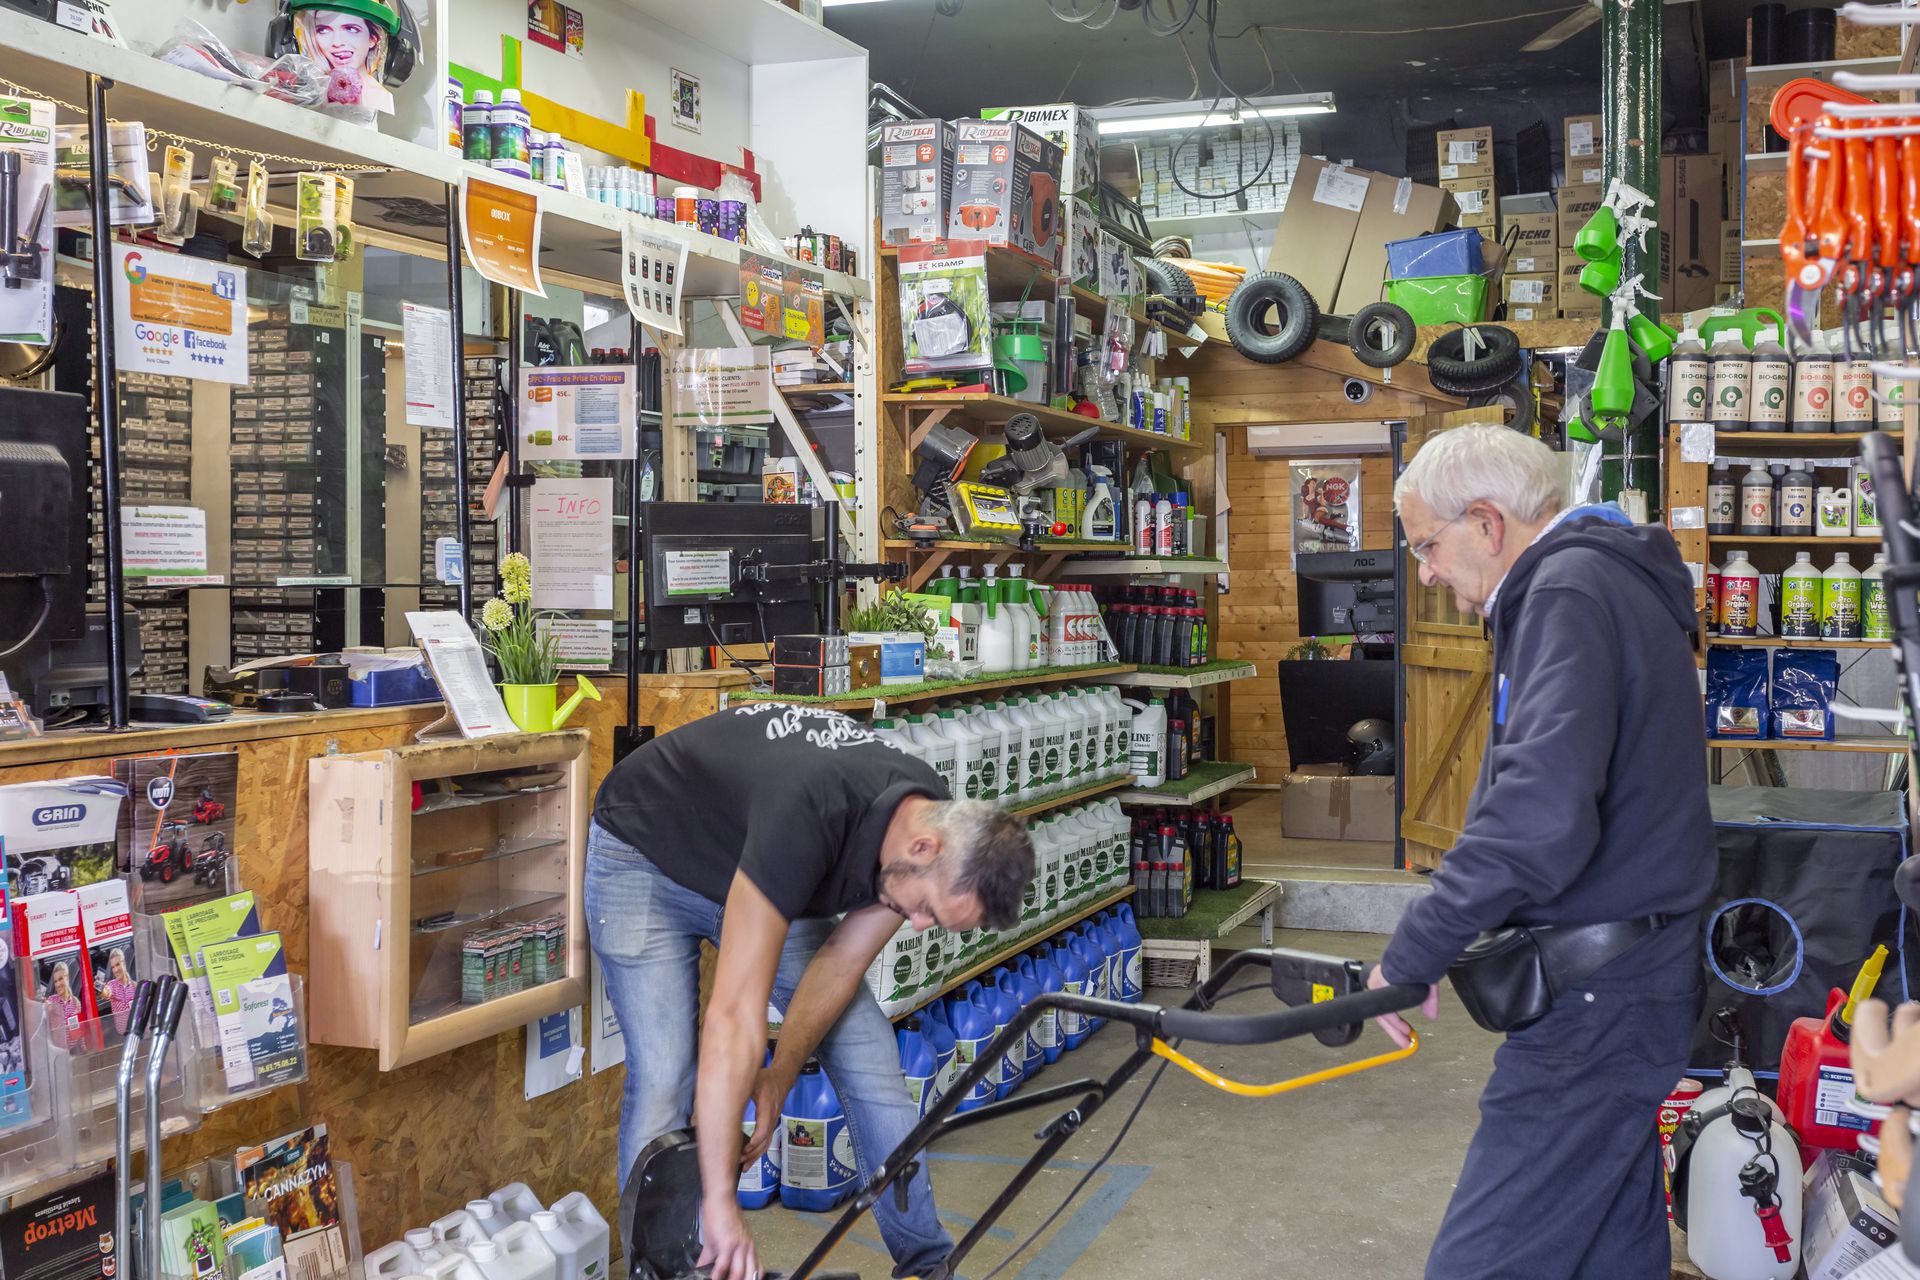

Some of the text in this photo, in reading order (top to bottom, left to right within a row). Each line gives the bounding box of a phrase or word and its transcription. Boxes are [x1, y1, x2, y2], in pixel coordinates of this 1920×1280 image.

[1007, 109, 1069, 123] RIBIMEX
[887, 126, 934, 141] RIBITECH
[962, 125, 1010, 140] RIBITECH
[920, 146, 931, 154] 22
[994, 148, 1006, 156] 22
[1518, 229, 1551, 240] ECHO
[931, 259, 964, 268] KRAMP
[762, 267, 782, 280] CARLTON
[135, 323, 179, 347] Google
[196, 336, 227, 351] facebook
[562, 375, 571, 383] de
[572, 375, 588, 383] Prise
[589, 374, 598, 382] En
[599, 374, 622, 383] Charge
[1326, 482, 1345, 491] NGK
[557, 497, 601, 516] INFO
[1793, 594, 1808, 602] Pro
[1838, 595, 1852, 603] Pro
[1130, 733, 1151, 742] LINE
[38, 806, 80, 823] GRIN
[61, 935, 74, 943] LIGNE
[896, 934, 923, 953] MARLIN
[211, 957, 218, 965] DE
[243, 999, 269, 1013] Soforest
[264, 1162, 327, 1203] CANNAZYM
[24, 1205, 97, 1245] Metrop
